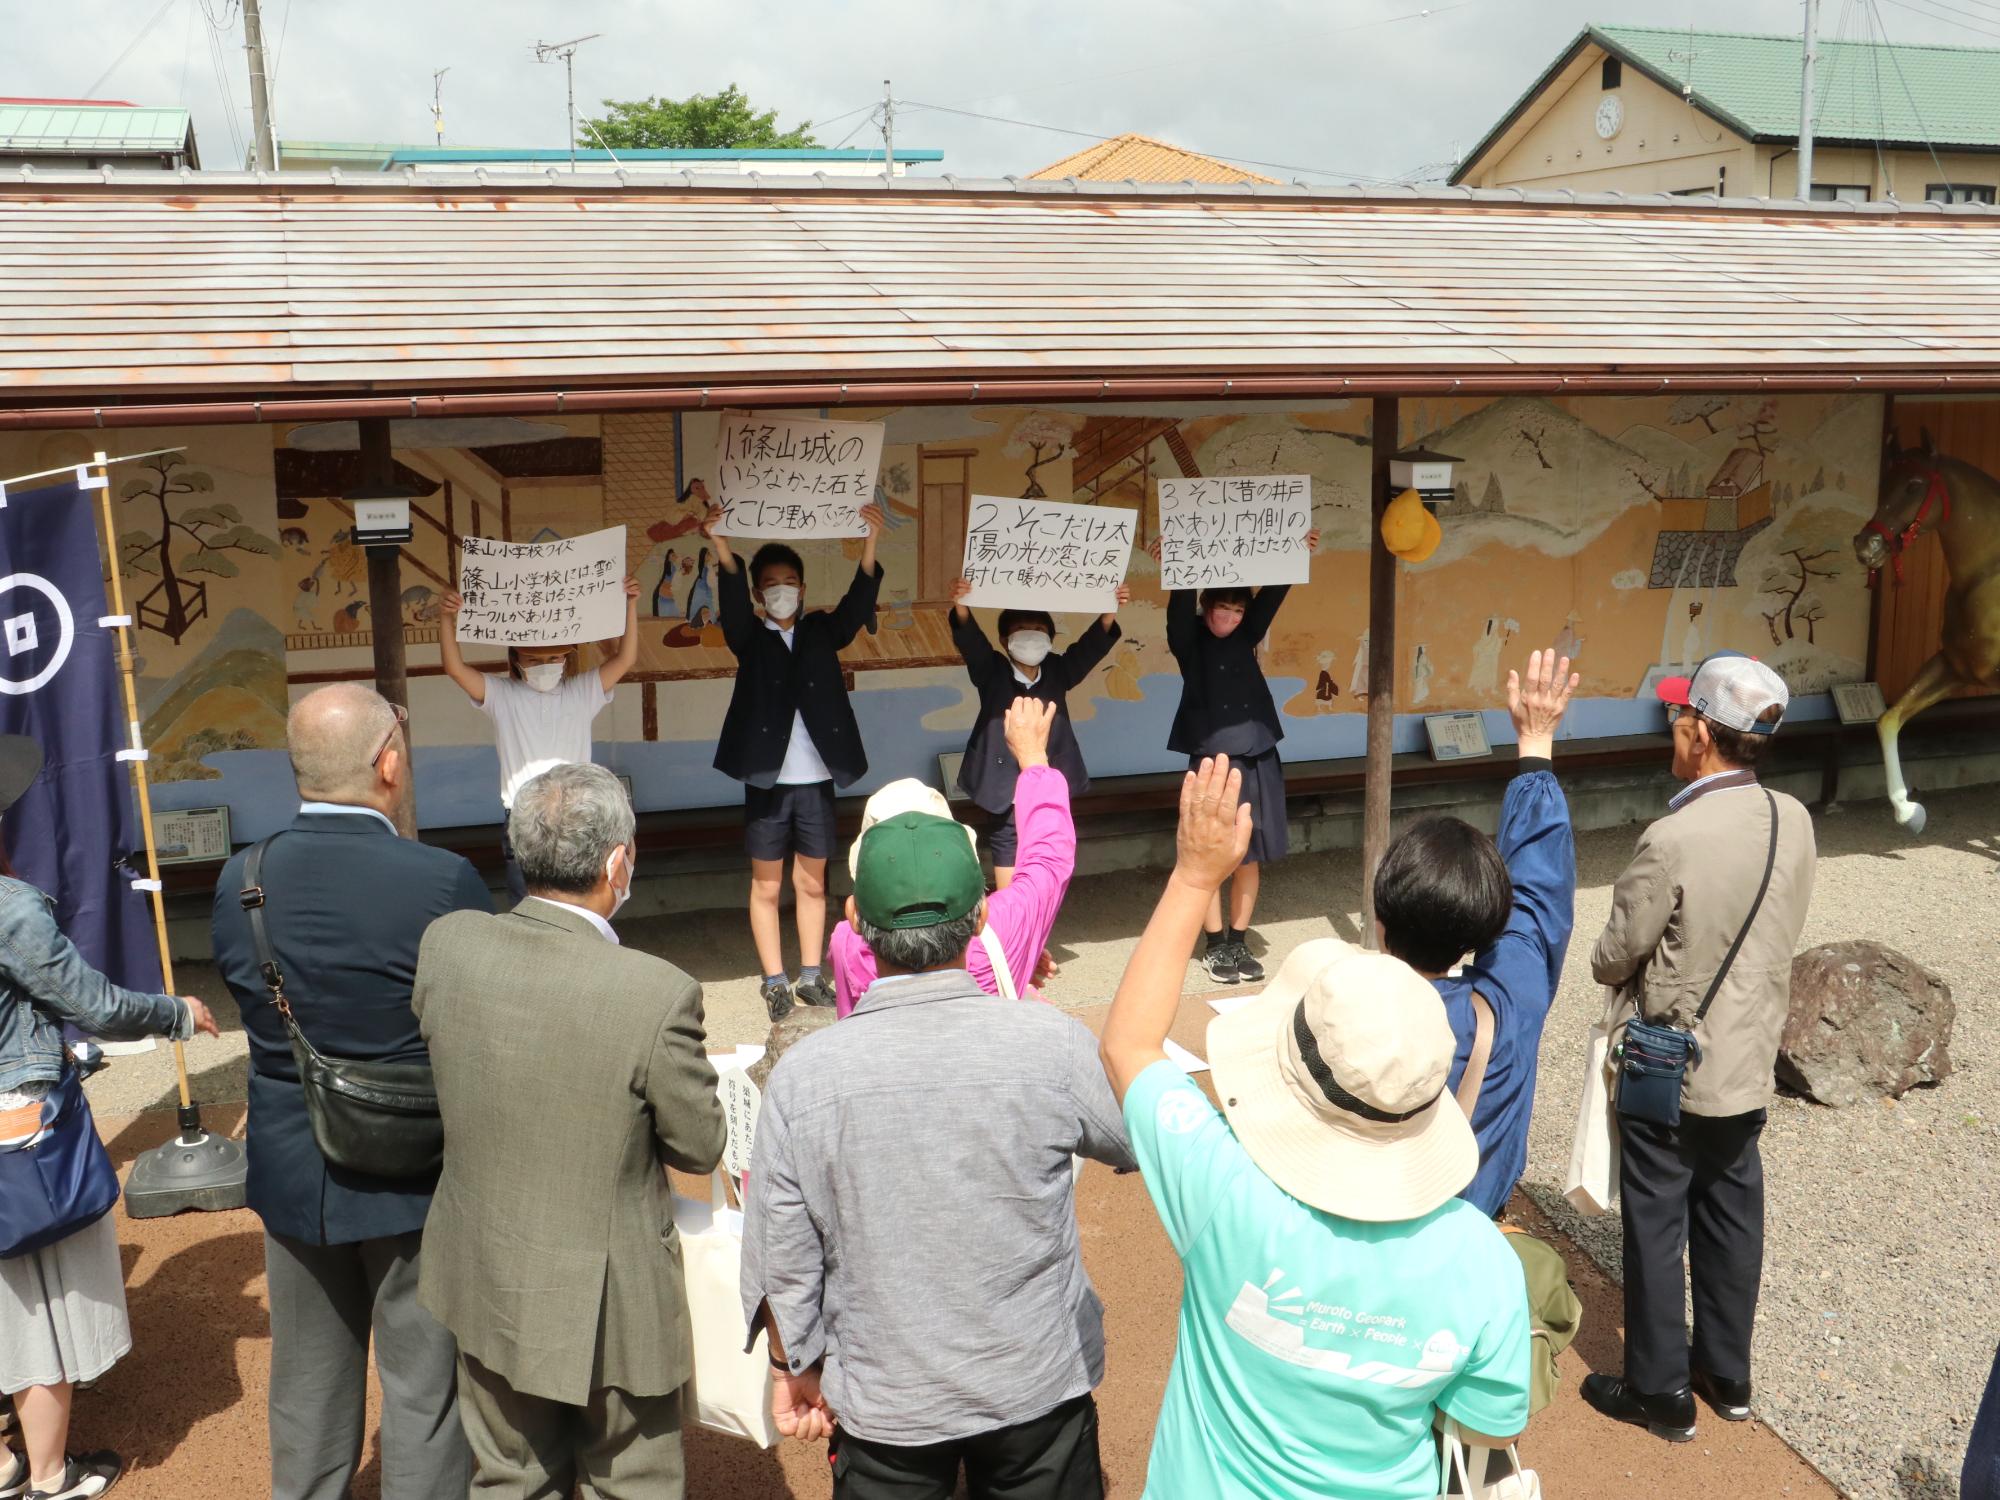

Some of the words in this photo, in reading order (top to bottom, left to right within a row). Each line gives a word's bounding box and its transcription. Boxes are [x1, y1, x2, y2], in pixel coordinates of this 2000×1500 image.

[719, 462, 869, 497] いらなかった石を
[719, 495, 868, 533] そこに埋めているか。
[1163, 507, 1306, 537] があり、内側の
[463, 538, 576, 559] 篠山小学校クイズ
[969, 533, 1121, 569] 陽の光が窓に反
[1163, 536, 1309, 563] 空気があたたかく
[1163, 561, 1245, 587] なるから。
[462, 580, 616, 607] 積もっても溶けるミステリー
[1306, 1301, 1352, 1320] Muroto
[1355, 1312, 1407, 1329] Geopark
[1309, 1318, 1346, 1335] Earth
[1364, 1328, 1408, 1347] People
